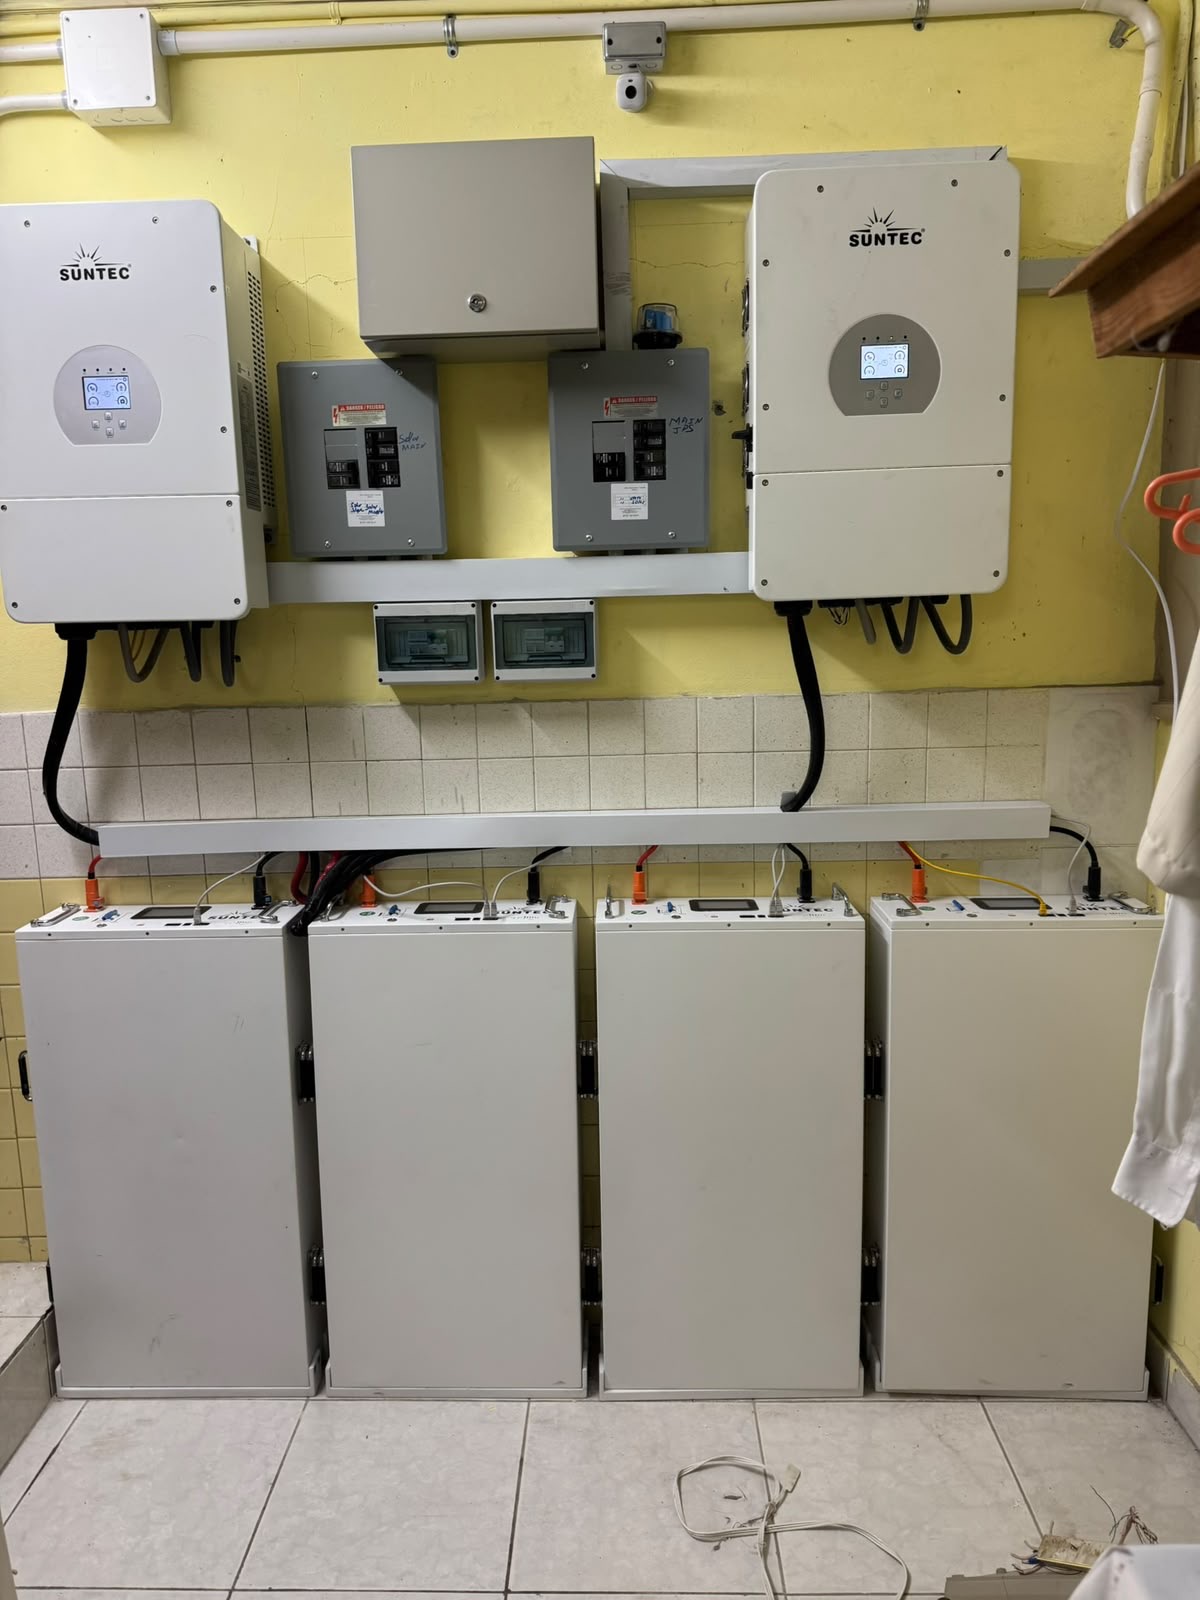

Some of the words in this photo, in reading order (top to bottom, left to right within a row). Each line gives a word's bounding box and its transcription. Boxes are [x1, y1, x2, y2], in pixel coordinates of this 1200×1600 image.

[849, 231, 922, 247] SUNTEC
[60, 267, 129, 281] SUNTEC
[669, 416, 703, 426] MAIN
